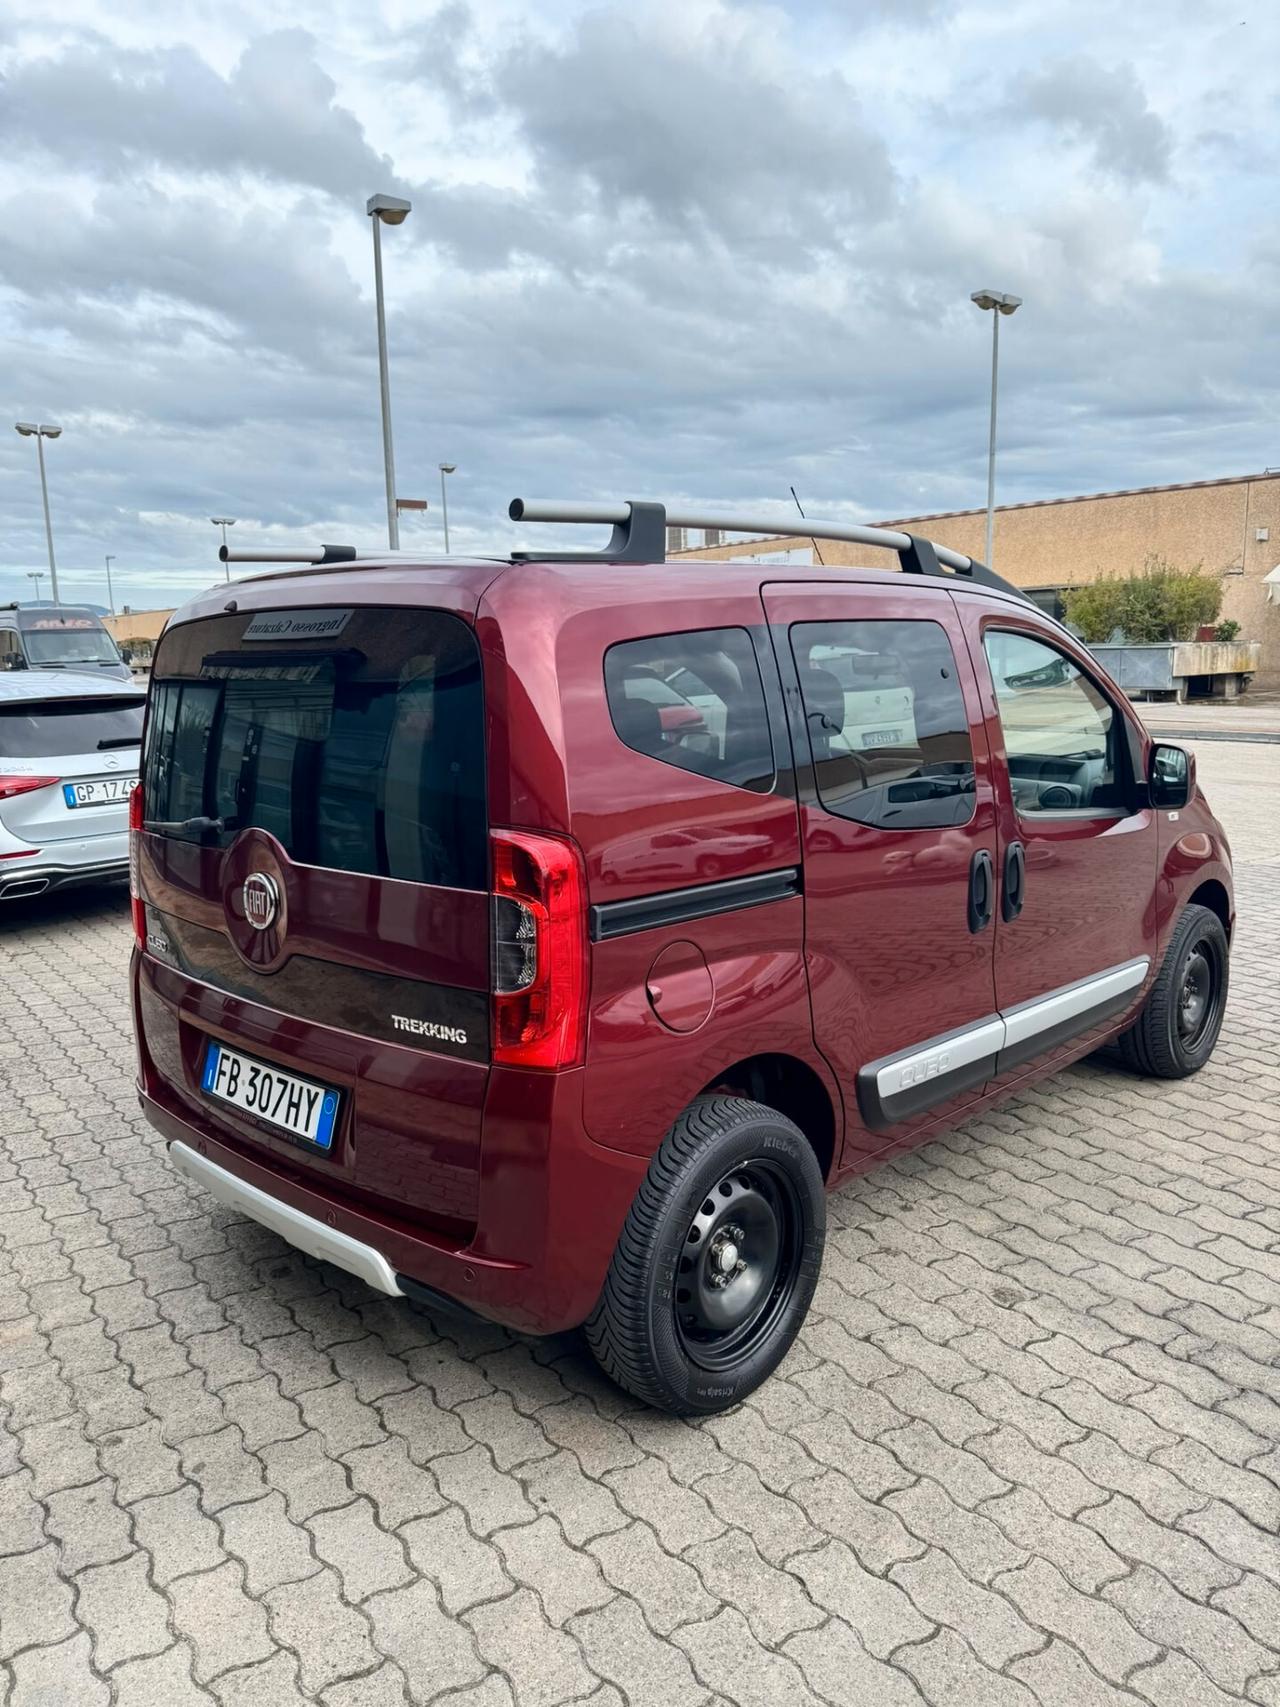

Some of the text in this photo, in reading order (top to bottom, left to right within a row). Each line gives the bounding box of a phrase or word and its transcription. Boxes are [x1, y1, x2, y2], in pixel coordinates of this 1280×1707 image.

[76, 784, 95, 801] GP
[249, 889, 266, 916] FIAT
[391, 1014, 468, 1044] TREKKING
[215, 1052, 242, 1098] FB
[245, 1065, 320, 1133] 307HY
